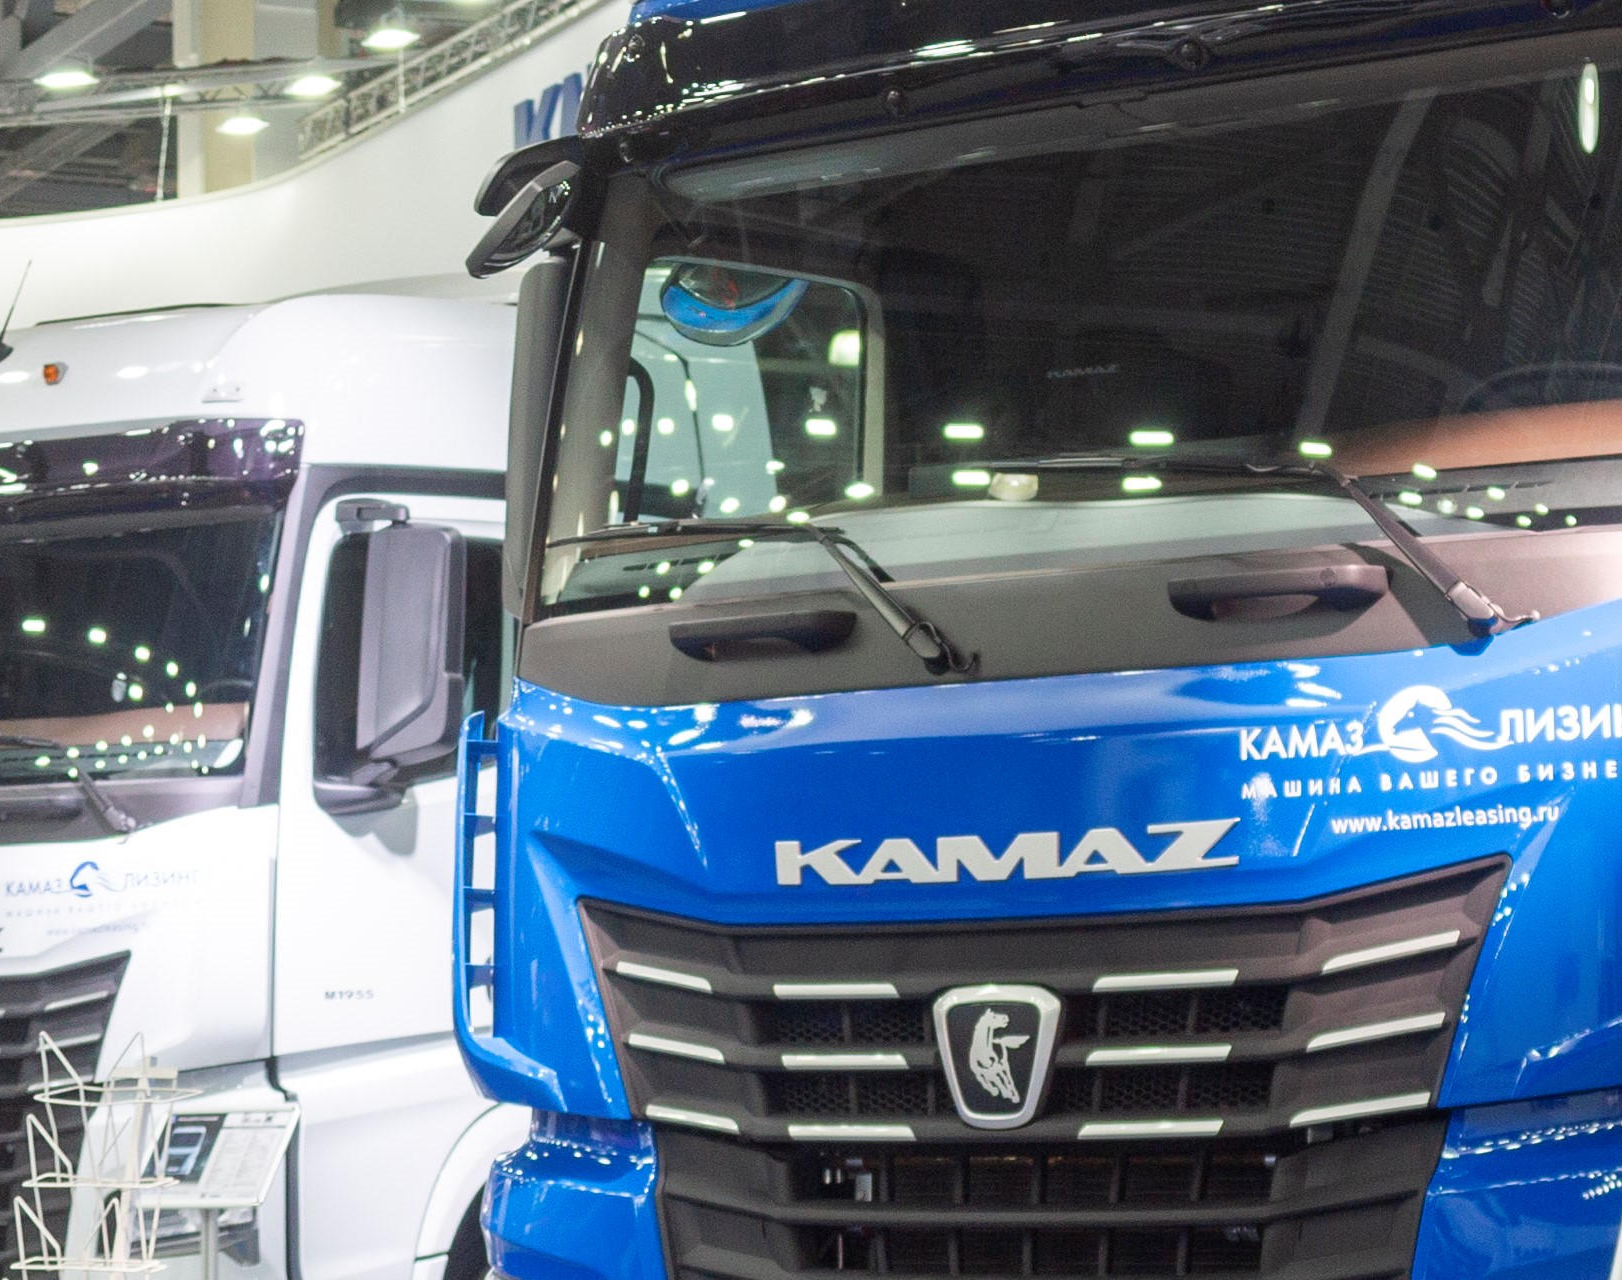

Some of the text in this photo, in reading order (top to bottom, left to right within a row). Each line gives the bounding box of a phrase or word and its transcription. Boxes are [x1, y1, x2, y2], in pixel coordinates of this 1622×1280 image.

[1239, 774, 1363, 801] МАШИНА
[1380, 766, 1500, 793] ВАШЕГО
[1330, 802, 1561, 834] www.kamazleasing.ru
[774, 816, 1241, 887] KAMAZ
